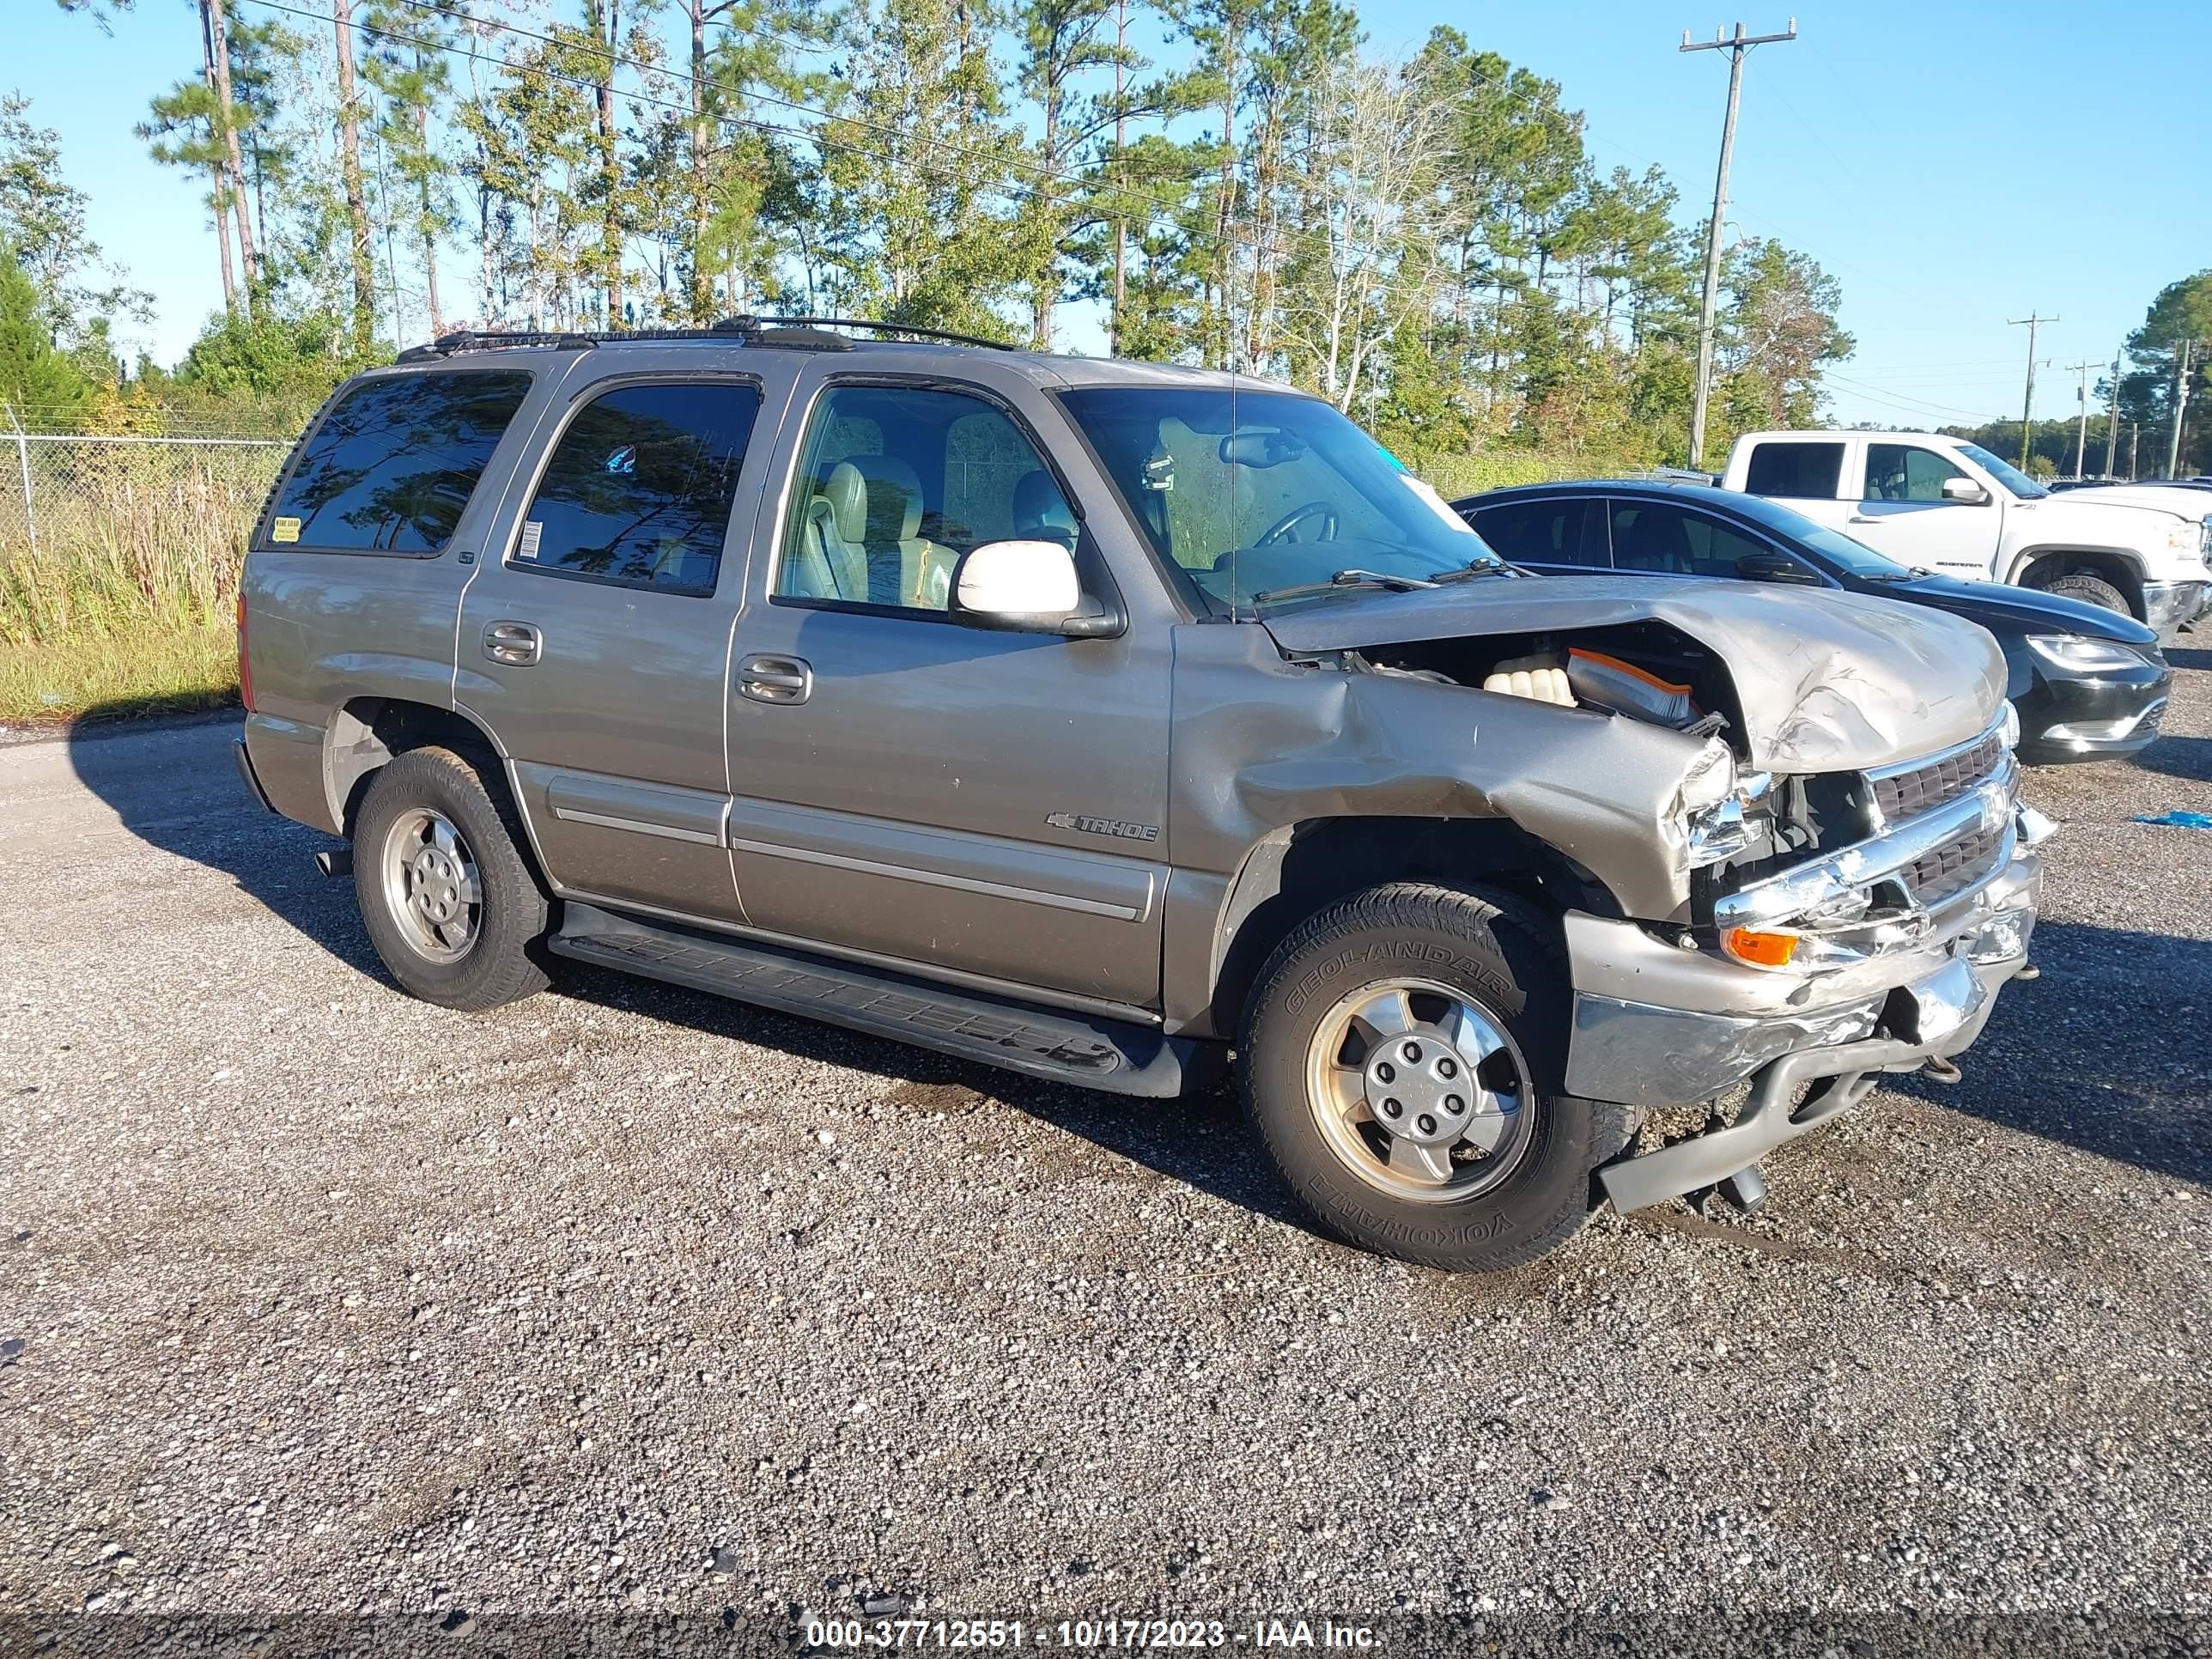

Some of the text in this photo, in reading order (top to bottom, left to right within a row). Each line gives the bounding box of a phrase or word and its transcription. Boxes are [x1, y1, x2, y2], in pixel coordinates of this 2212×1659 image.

[459, 553, 474, 563] LT
[1079, 816, 1160, 842] TAHOE
[1285, 940, 1514, 1016] GEOLANDAR
[1309, 1172, 1516, 1247] YOKOHAMA
